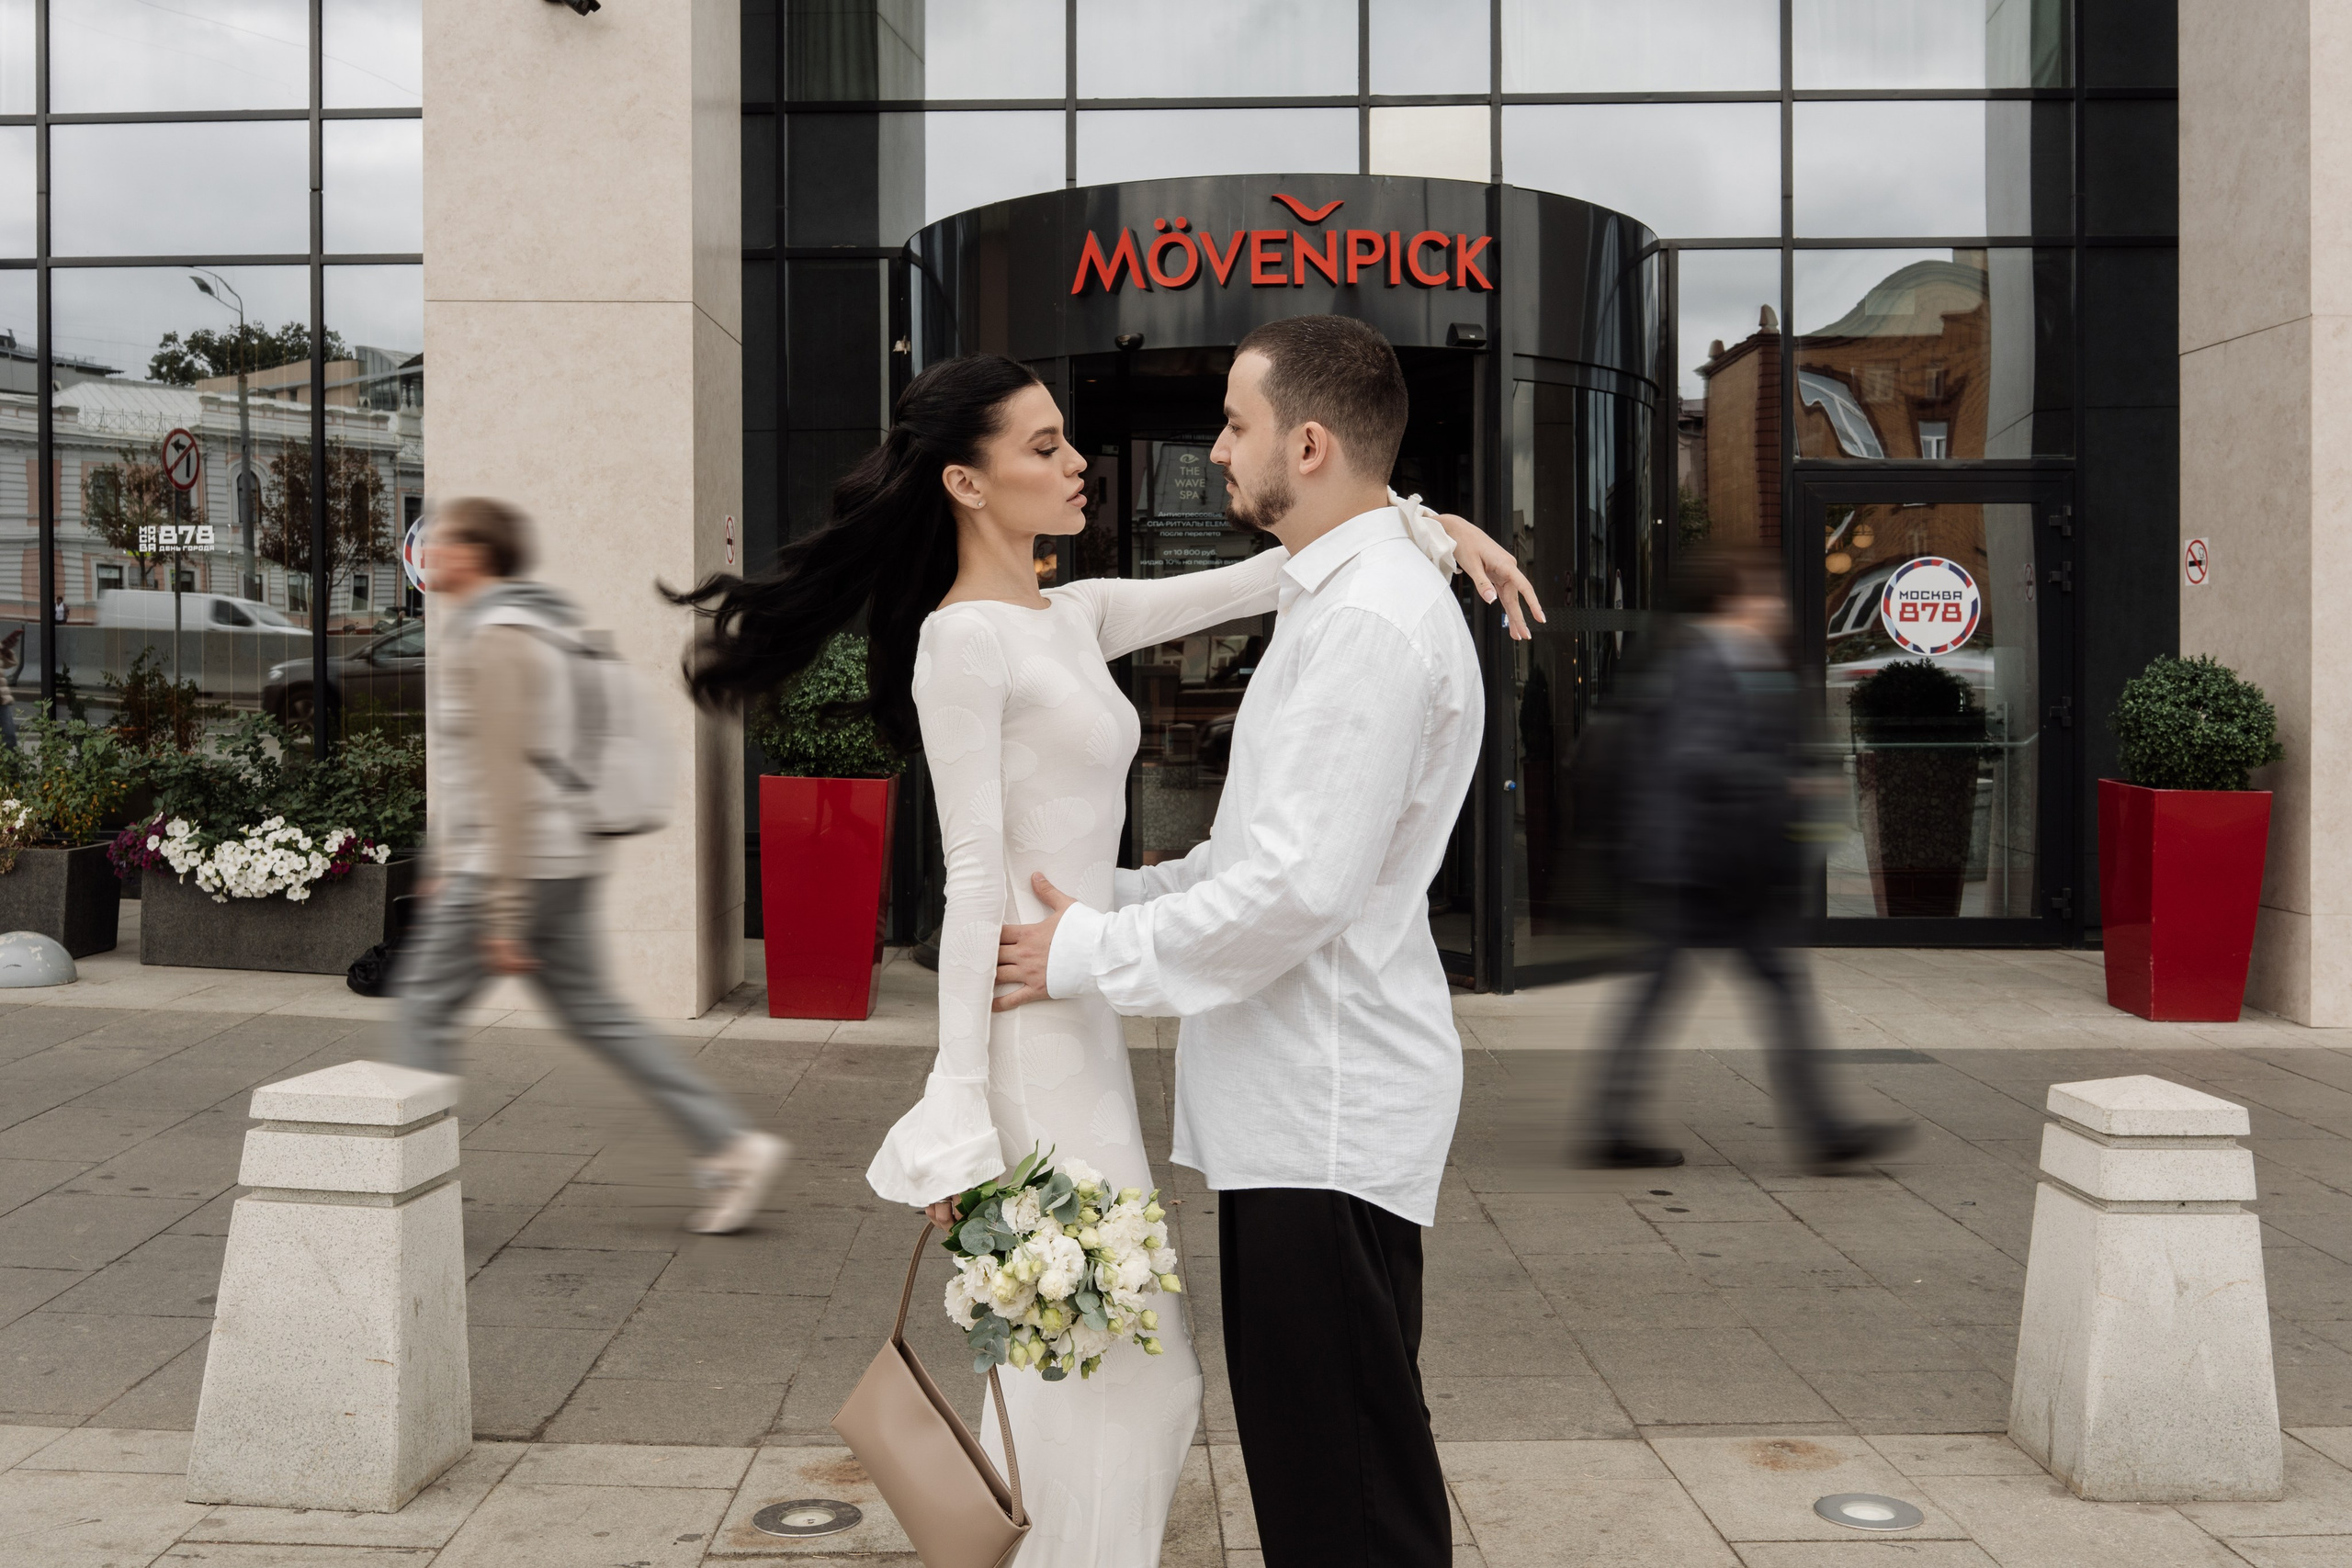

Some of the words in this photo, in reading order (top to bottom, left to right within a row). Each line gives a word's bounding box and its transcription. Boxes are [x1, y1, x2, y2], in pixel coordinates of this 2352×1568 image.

[1071, 216, 1494, 295] MÖVENPICK
[1180, 467, 1200, 476] THE
[1174, 479, 1205, 488] WAVE
[1180, 491, 1200, 500] SPA
[159, 525, 215, 545] 878
[1899, 591, 1962, 601] МОСКВА
[1899, 603, 1962, 623] 878
